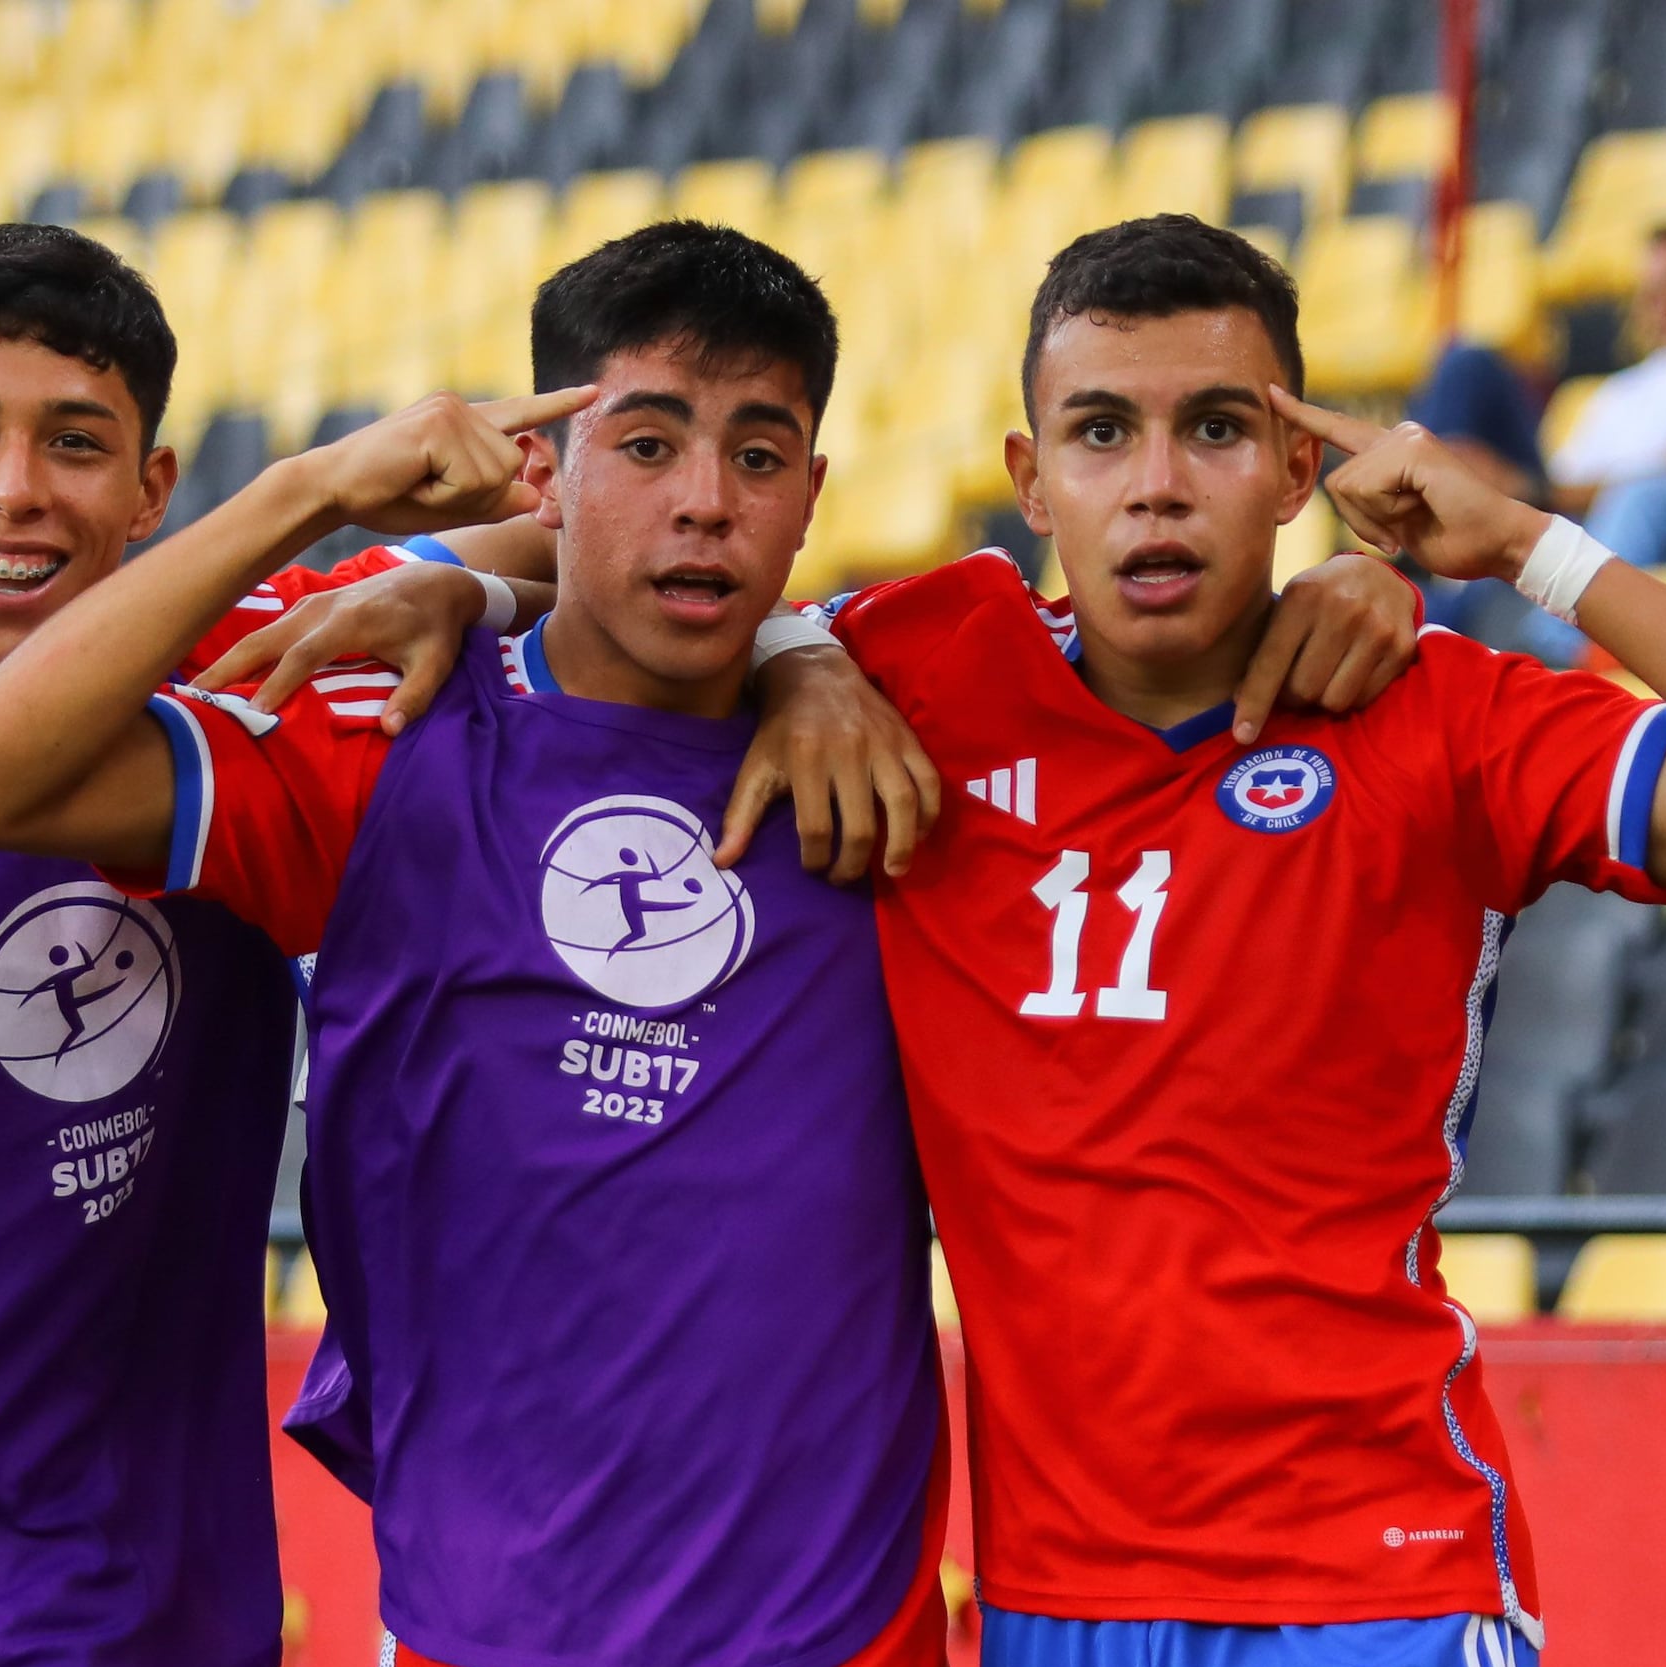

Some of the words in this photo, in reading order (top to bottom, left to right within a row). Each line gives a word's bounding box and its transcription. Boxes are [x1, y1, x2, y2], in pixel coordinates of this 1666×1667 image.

[1222, 749, 1283, 789] FEDERACION
[1291, 749, 1308, 760] DE
[1308, 755, 1333, 788] FUTBOL
[1242, 813, 1260, 826] DE
[1266, 814, 1302, 829] CHILE
[1019, 849, 1171, 1020] 11
[559, 1039, 700, 1094] SUB17
[582, 1088, 664, 1124] 2023
[51, 1126, 155, 1197] SUB17
[83, 1177, 134, 1225] 2023
[1409, 1529, 1465, 1541] AEROREADY
